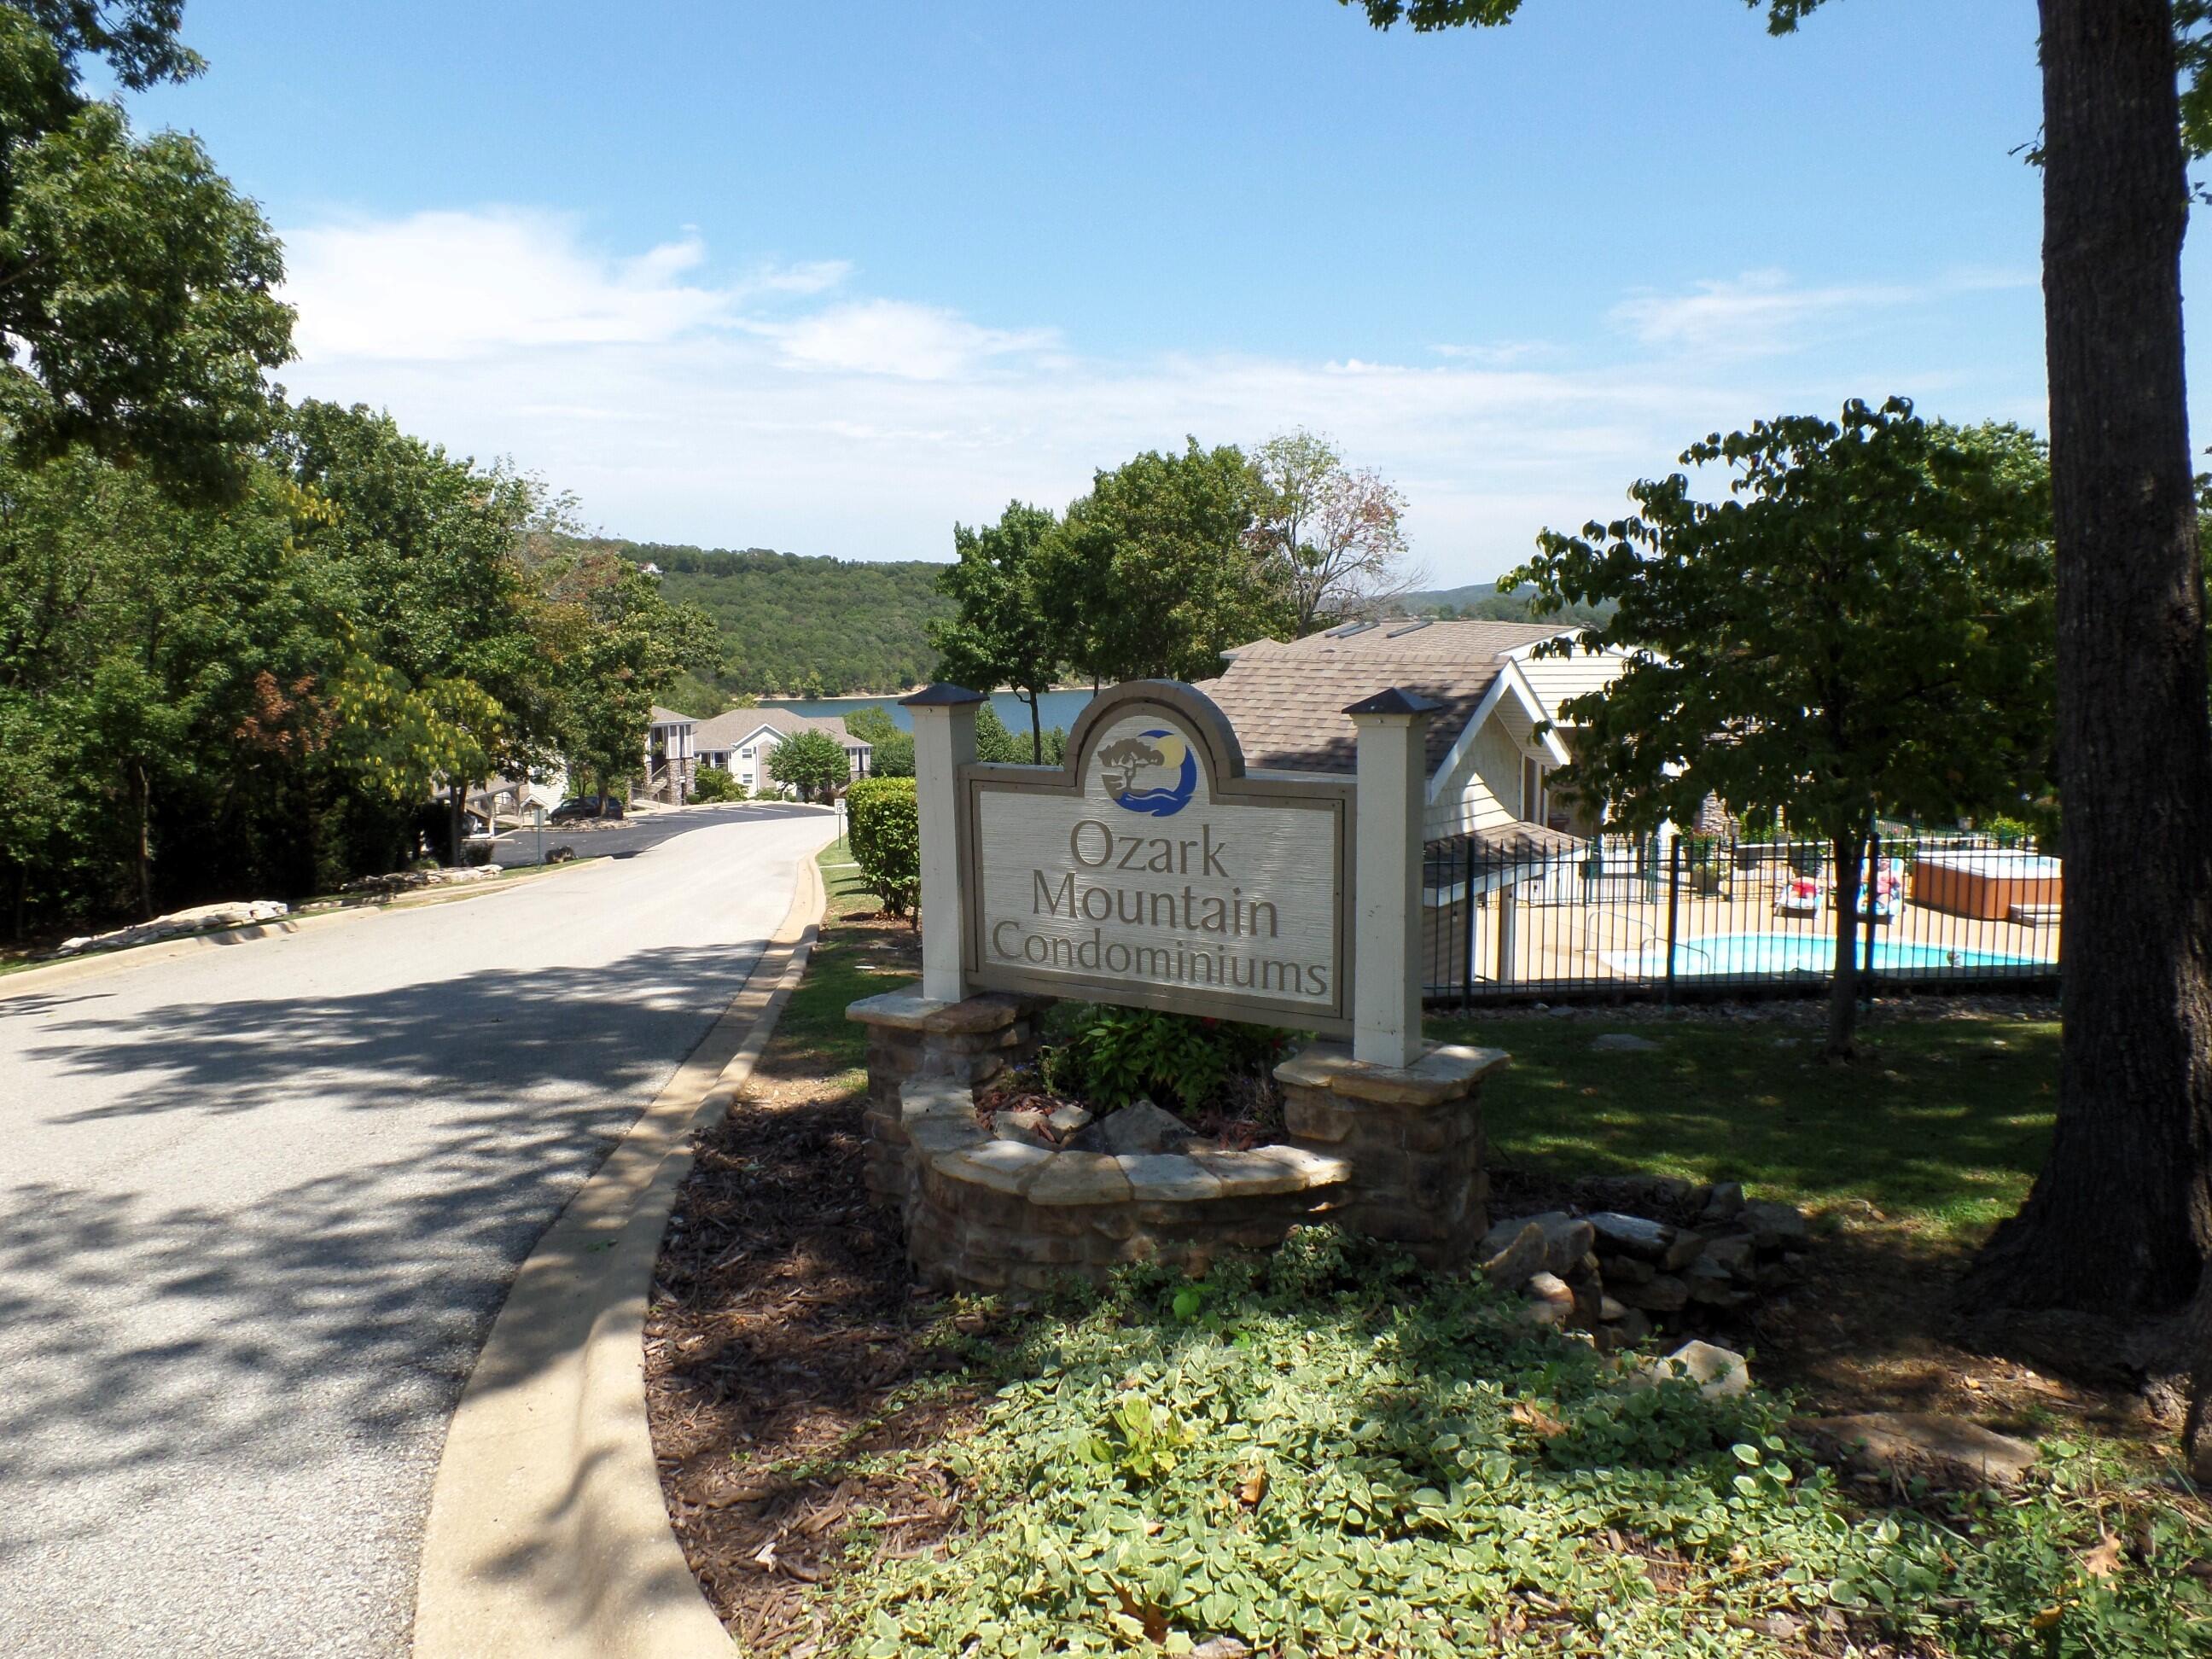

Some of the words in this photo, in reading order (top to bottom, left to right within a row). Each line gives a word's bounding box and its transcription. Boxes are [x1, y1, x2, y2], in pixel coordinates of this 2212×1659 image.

[1070, 819, 1229, 877] Ozark
[1033, 869, 1278, 938] Mountain
[992, 920, 1328, 996] Condominiums
